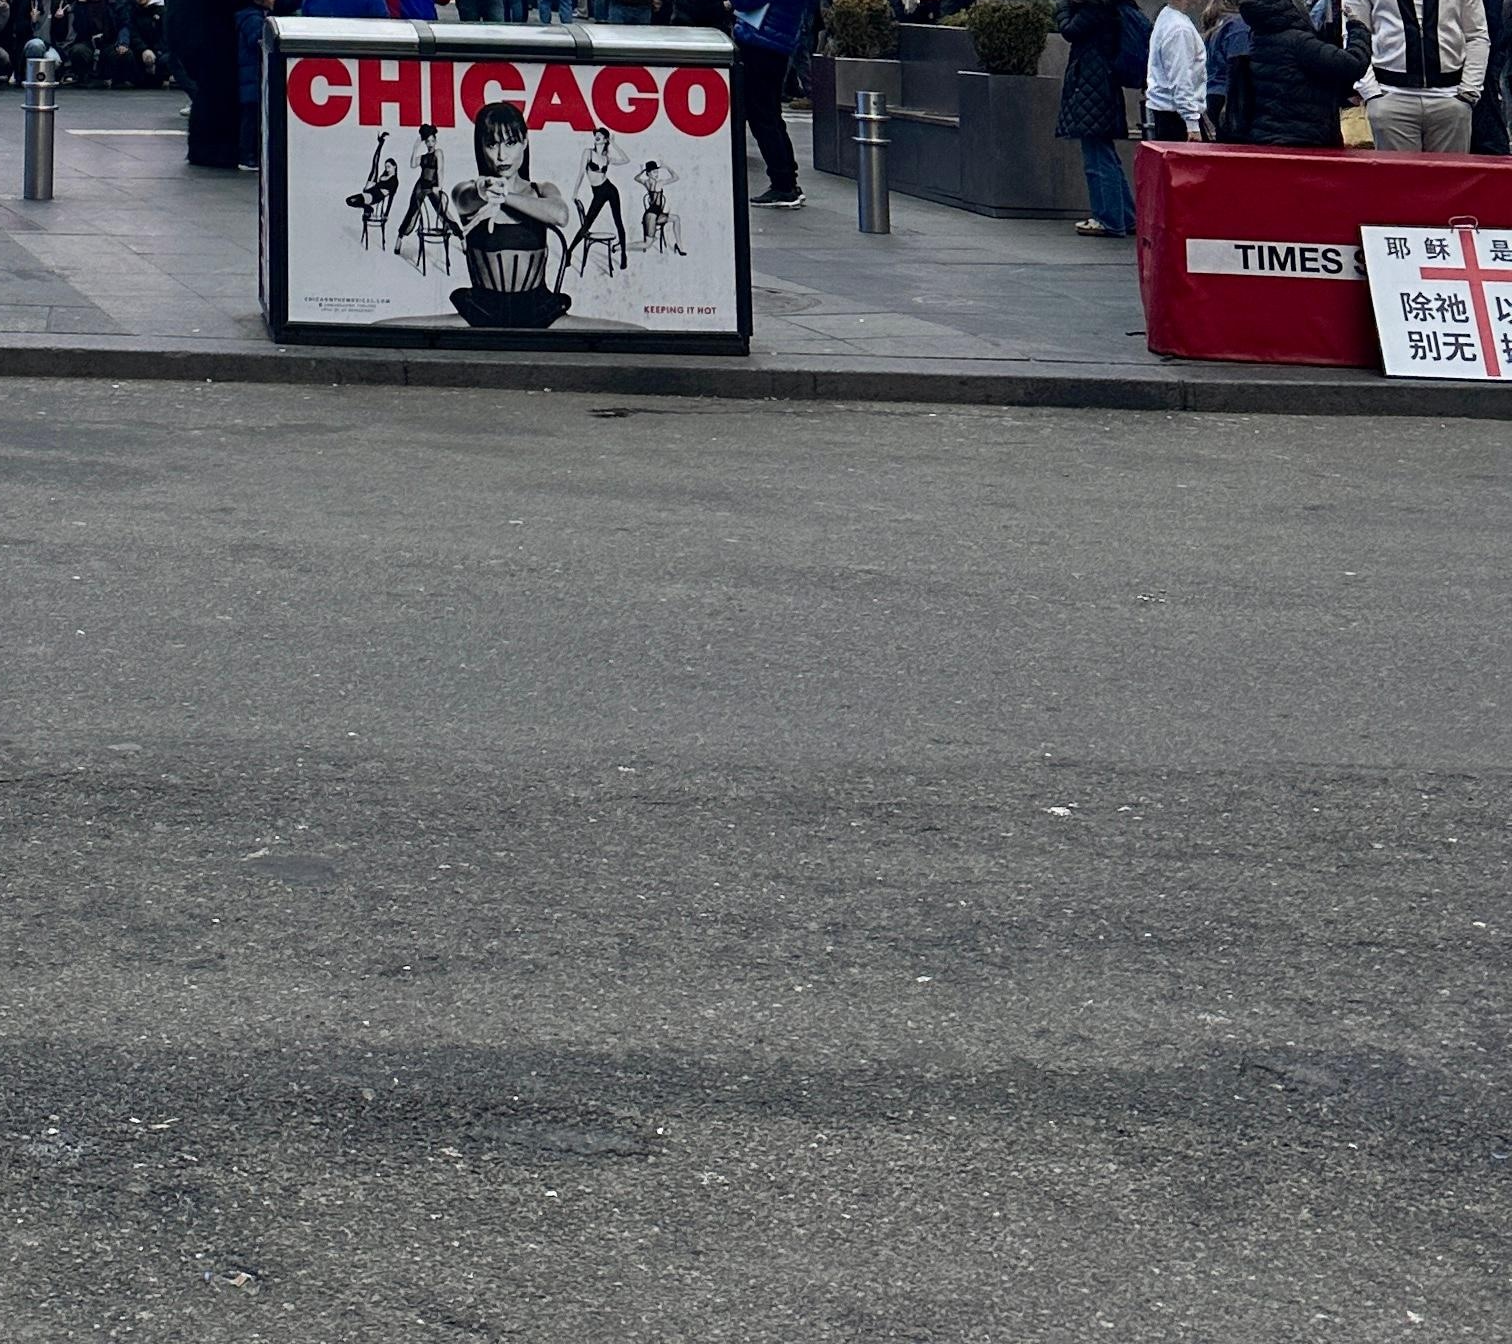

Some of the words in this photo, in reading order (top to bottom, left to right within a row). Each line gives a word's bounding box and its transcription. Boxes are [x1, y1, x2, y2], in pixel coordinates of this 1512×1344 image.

[288, 58, 730, 137] CHICAGO
[1234, 243, 1345, 275] TIMES
[1386, 236, 1452, 261] 耶稣
[643, 305, 685, 315] KEEPING
[697, 306, 718, 315] HOT
[1407, 331, 1478, 363] 别无
